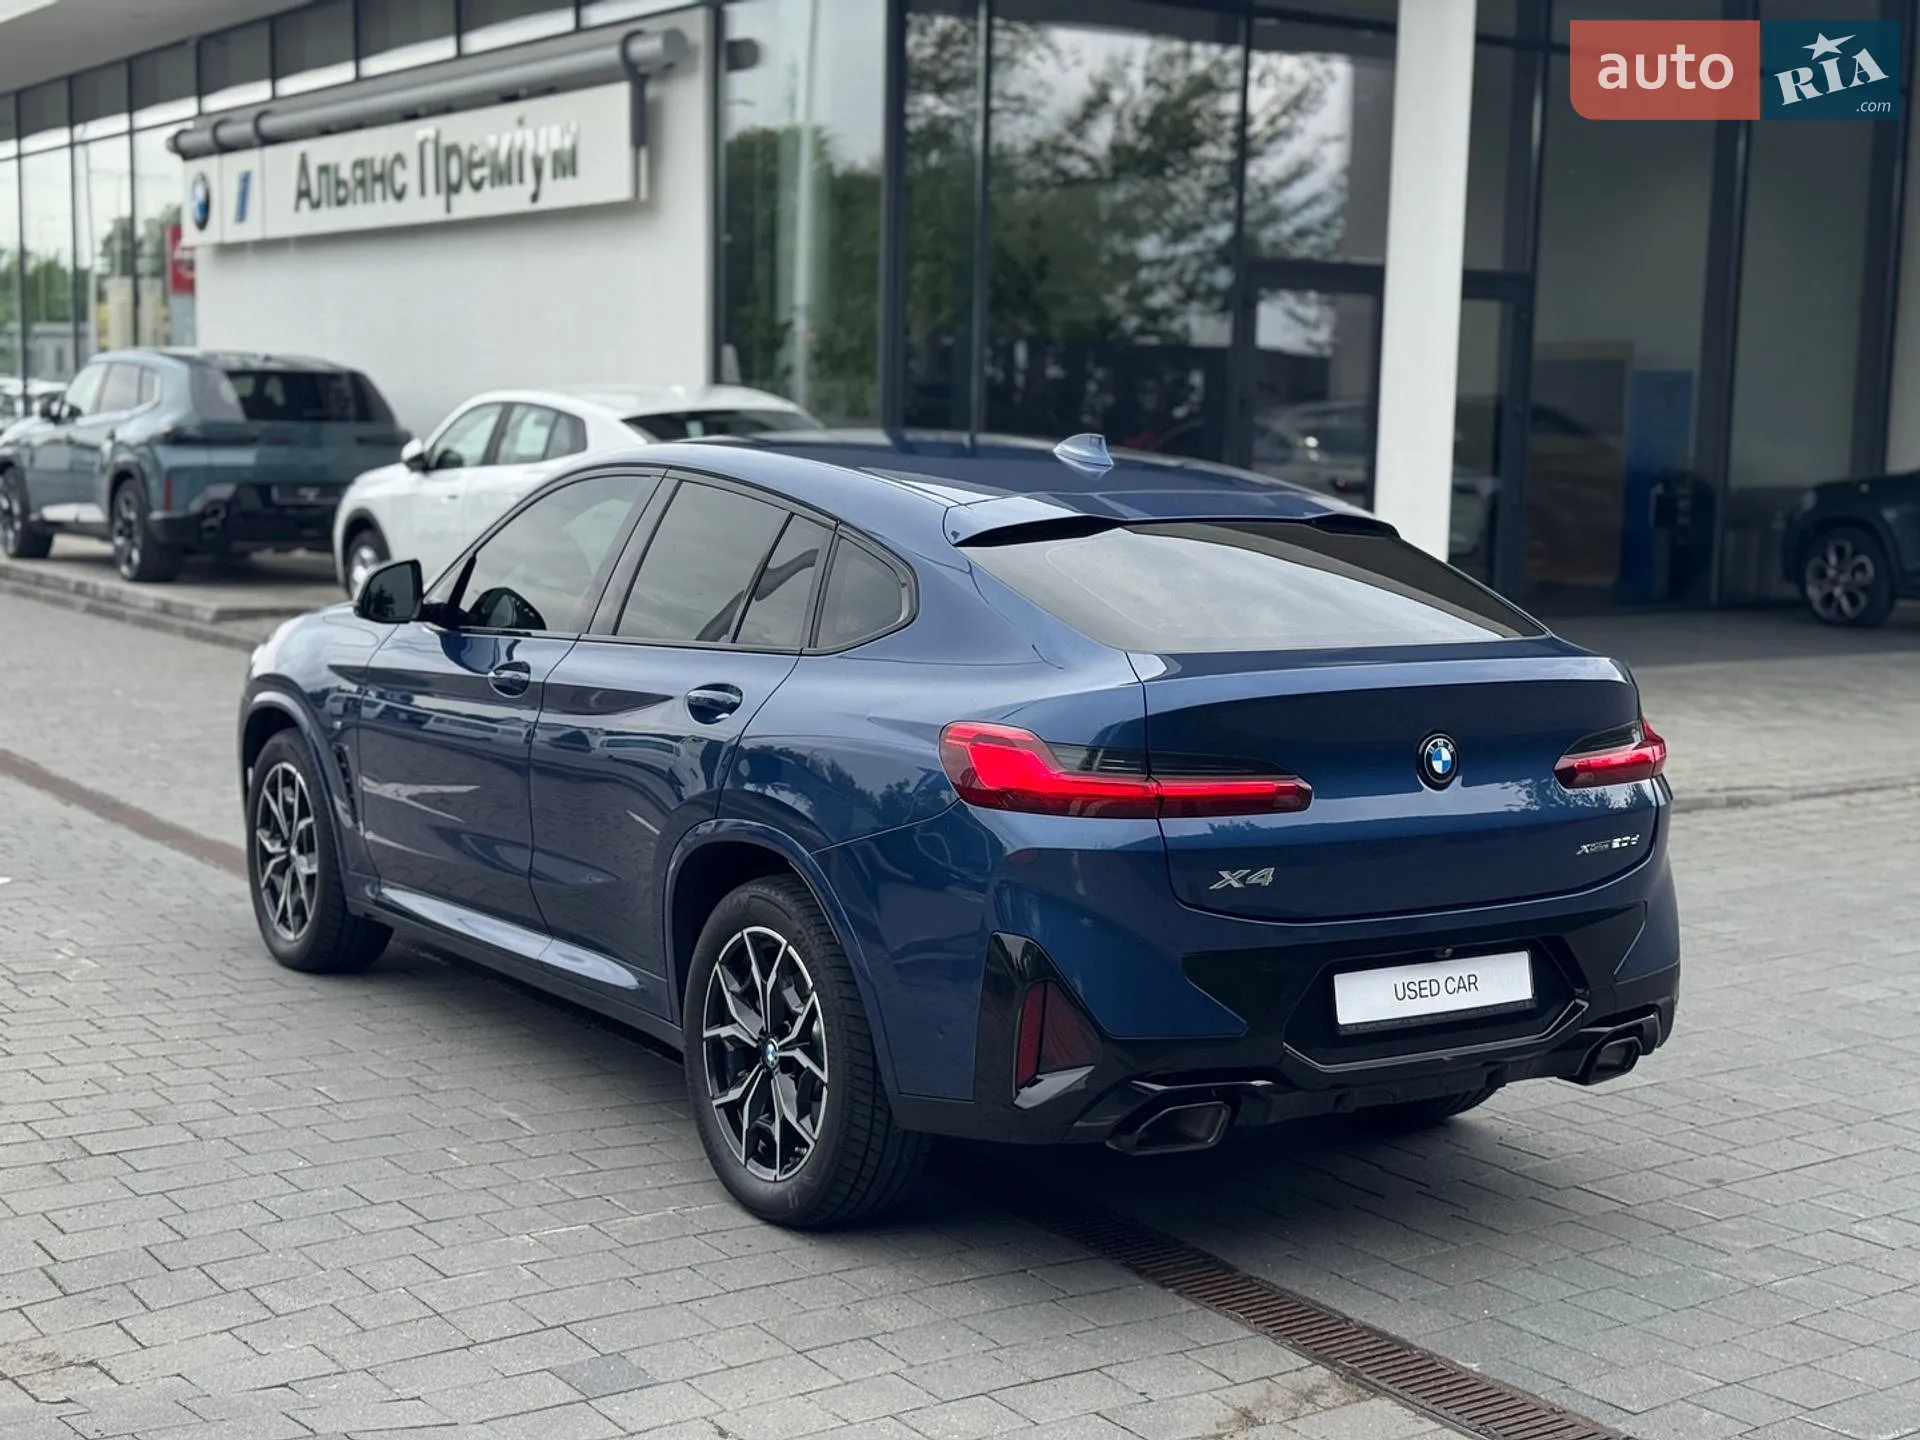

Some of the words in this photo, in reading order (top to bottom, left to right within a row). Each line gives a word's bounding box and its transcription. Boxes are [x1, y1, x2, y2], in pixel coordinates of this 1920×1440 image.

[294, 151, 408, 213] Альянс
[416, 114, 580, 214] Преміум
[1209, 867, 1275, 890] X4
[1394, 978, 1441, 1002] USED
[1445, 974, 1479, 996] CAR
